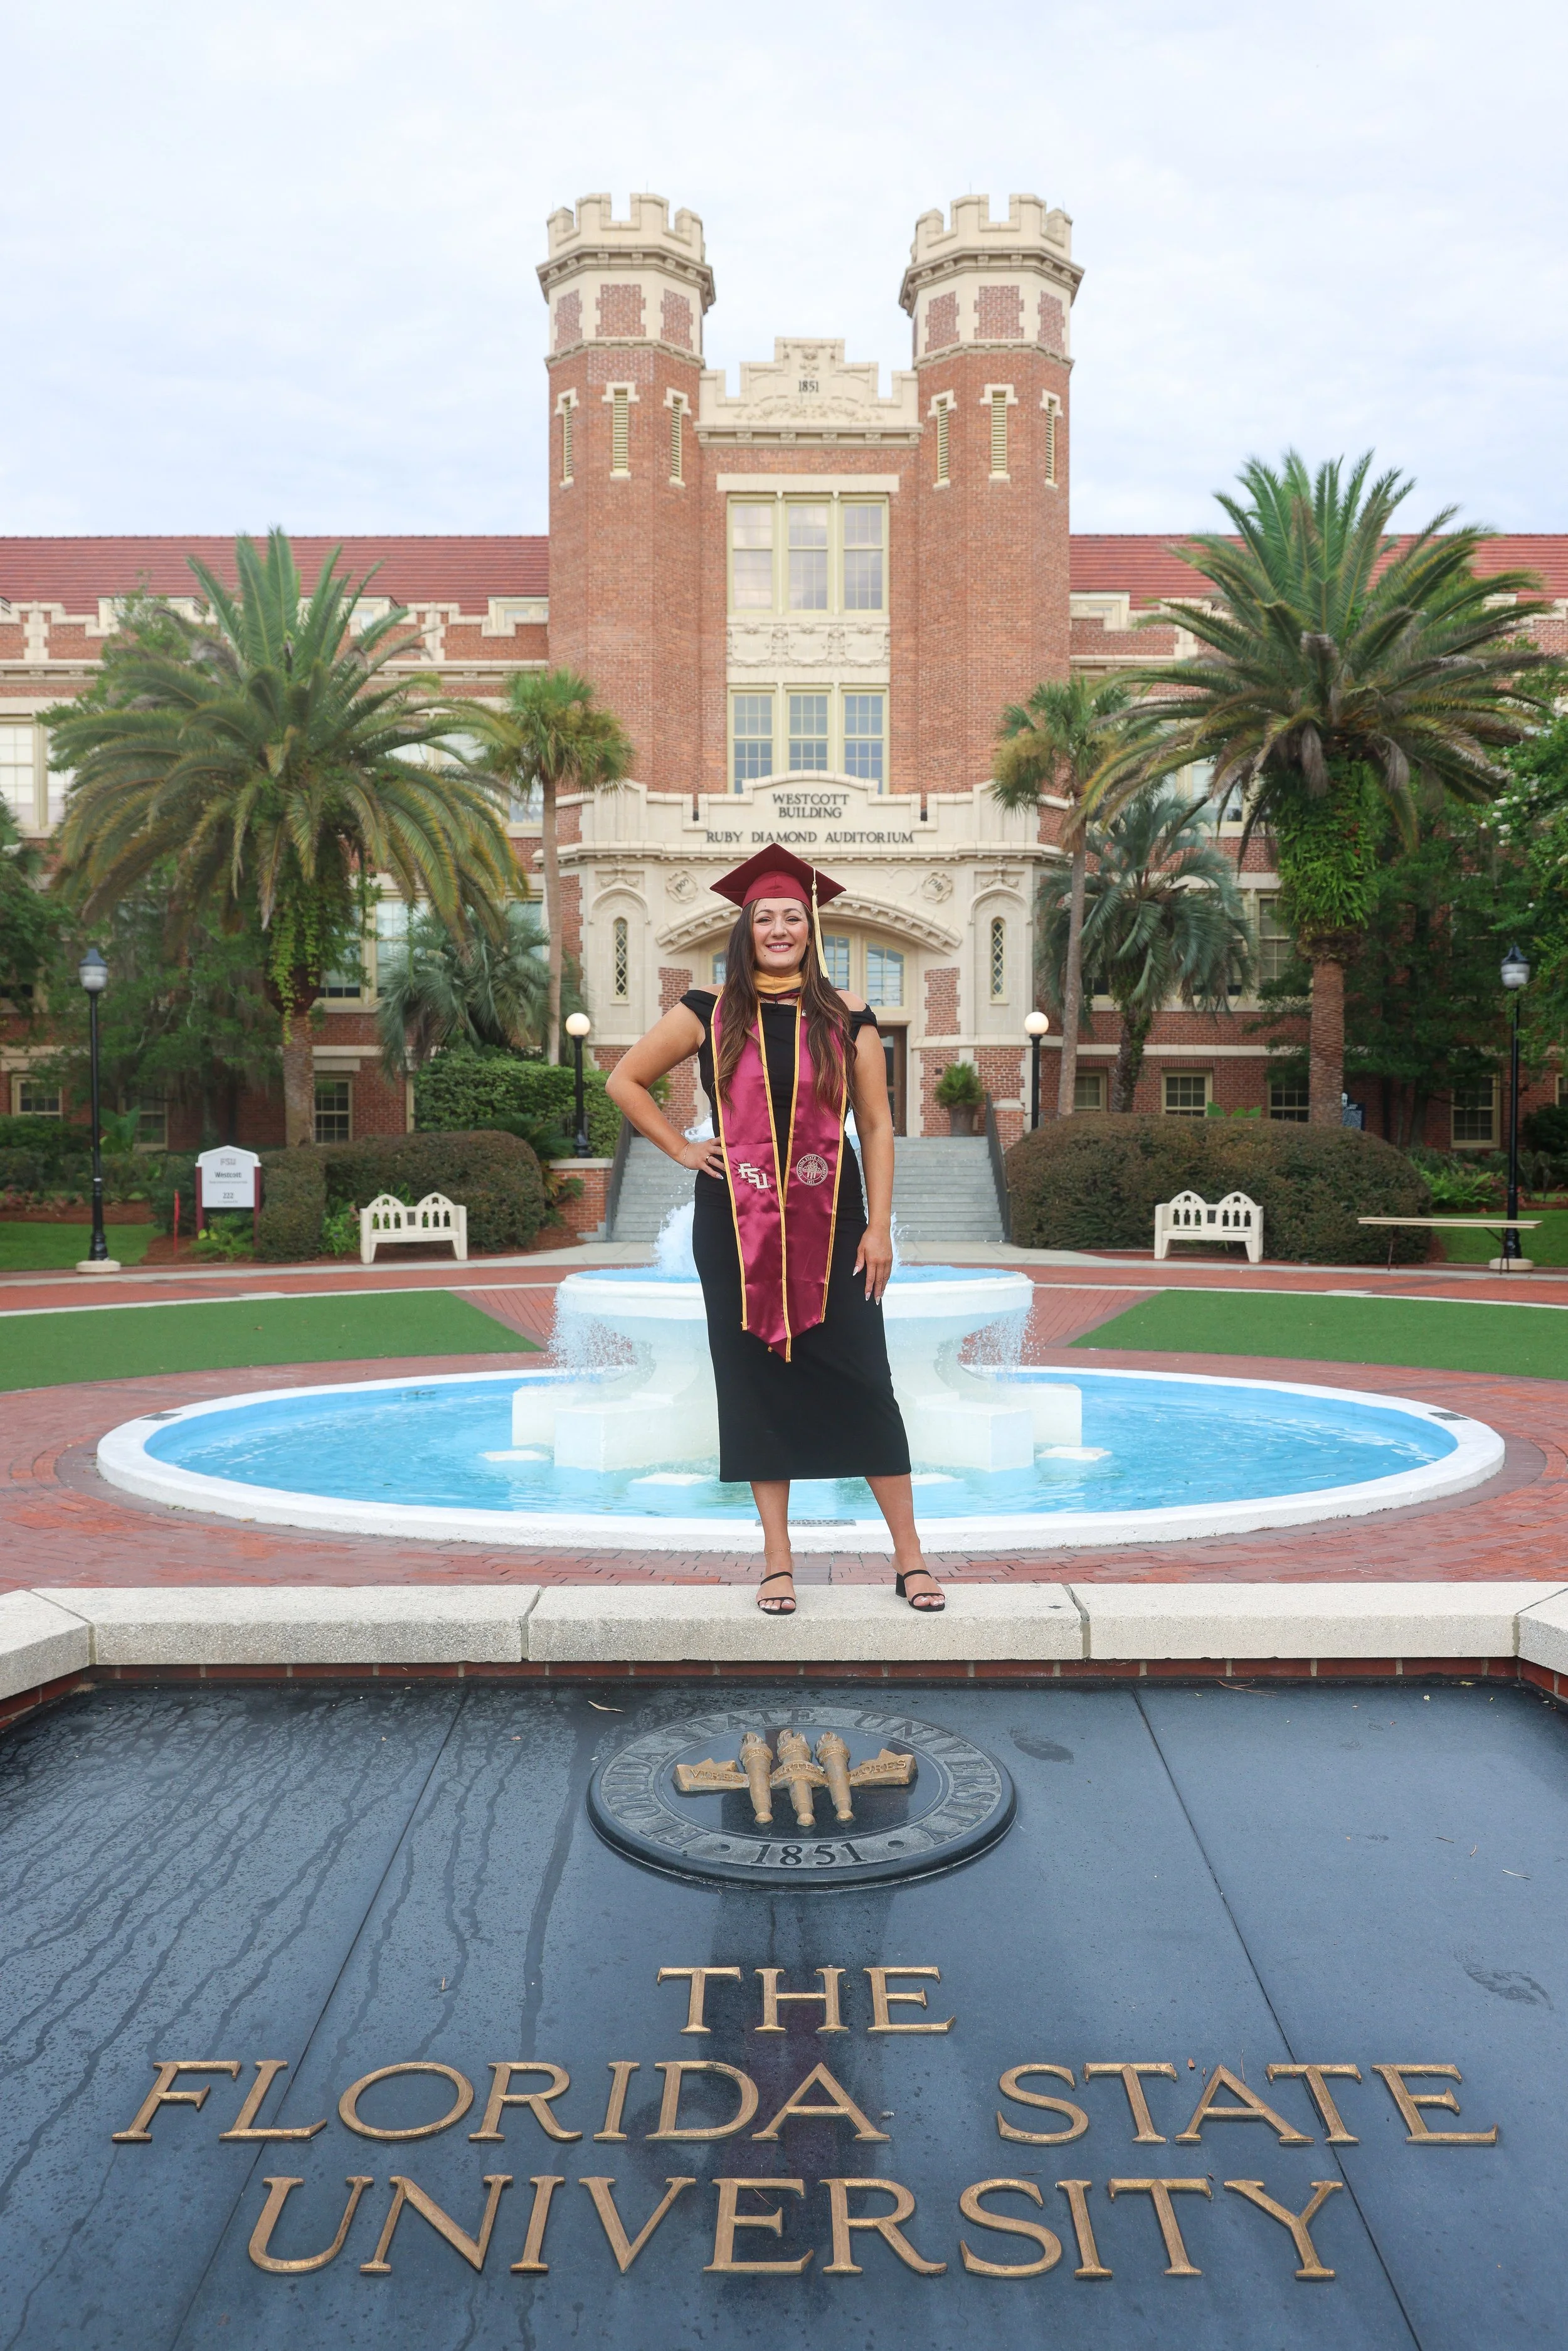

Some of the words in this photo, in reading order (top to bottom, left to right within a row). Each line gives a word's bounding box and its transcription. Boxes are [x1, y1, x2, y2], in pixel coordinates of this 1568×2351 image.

[798, 380, 818, 393] 1851
[772, 793, 850, 805] WESTCOTT
[778, 806, 842, 819] BUILDING
[706, 831, 744, 843] RUBY
[751, 831, 817, 843] DIAMOND
[824, 831, 914, 843] AUDITORIUM
[928, 878, 944, 891] 1910
[220, 1158, 236, 1166] FSU
[737, 1162, 769, 1189] FSU
[605, 1751, 710, 1849] FLORIDA
[665, 1709, 817, 1743] STATE
[854, 1712, 997, 1845] UNIVERSITY
[689, 1768, 744, 1783] VIRES
[750, 1842, 867, 1866] 1851
[657, 1966, 956, 2034] THE
[112, 2059, 891, 2142] FLORIDA
[997, 2062, 1500, 2146] STATE
[248, 2175, 1345, 2281] UNIVERSITY
